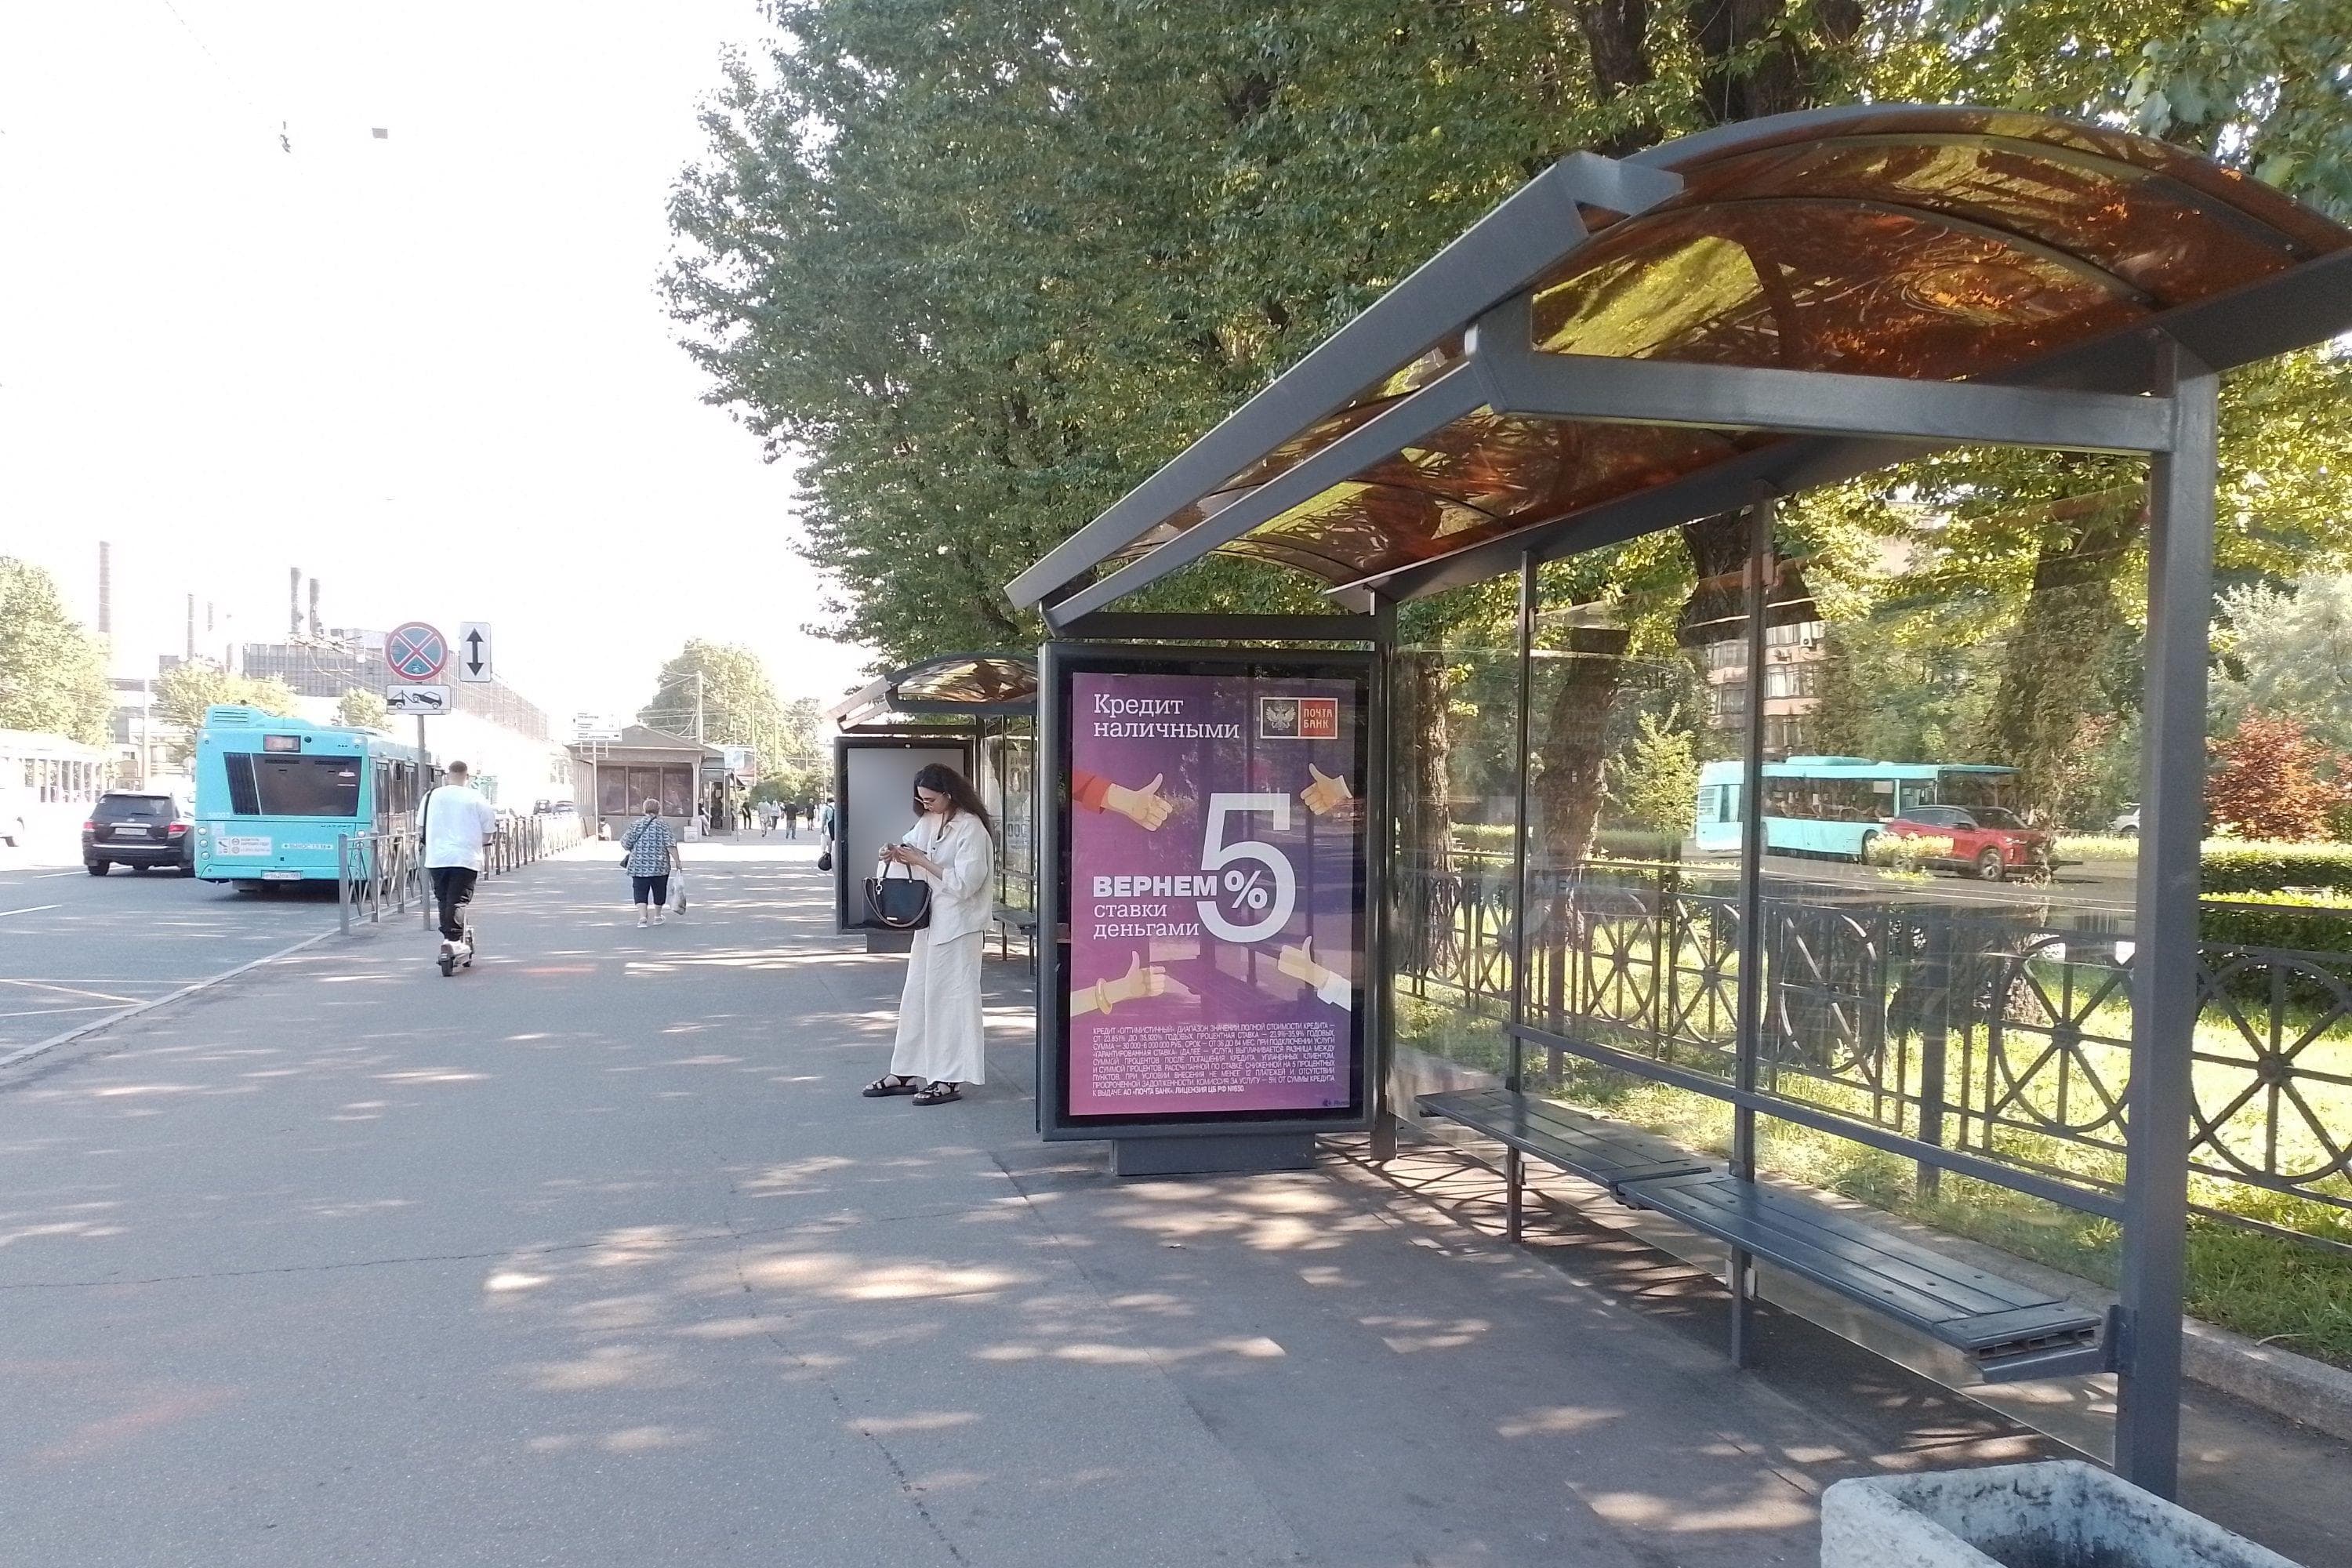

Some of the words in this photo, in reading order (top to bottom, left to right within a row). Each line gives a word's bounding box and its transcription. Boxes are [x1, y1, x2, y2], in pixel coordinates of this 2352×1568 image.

[1094, 693, 1184, 718] Кредит
[1304, 708, 1333, 718] ПОЧТА
[1093, 722, 1240, 739] наличными
[1303, 719, 1329, 729] БАНК
[1093, 875, 1218, 898] ВЕРНЕМ
[1094, 904, 1167, 918] ставки
[1093, 923, 1200, 940] деньгами
[1093, 1026, 1116, 1035] КРЕДИТ
[1240, 1023, 1265, 1032] ПОЛНОЙ
[1266, 1022, 1301, 1031] СТОИМОСТИ
[1303, 1022, 1328, 1030] КРЕДИТА
[1196, 1032, 1235, 1040] ПРОЦЕНТНАЯ
[1237, 1031, 1259, 1040] СТАВКА
[1269, 1037, 1312, 1046] ПОДКЛЮЧЕНИИ
[1313, 1036, 1334, 1045] УСЛУГИ
[1235, 1046, 1283, 1054] ВЫПЛАЧИВАЕТСЯ
[1286, 1045, 1312, 1054] РАЗНИЦА
[1314, 1044, 1334, 1053] МЕЖДУ
[1092, 1058, 1119, 1066] СУММОЙ
[1189, 1055, 1225, 1064] ПОГАШЕНИЯ
[1261, 1053, 1298, 1062] УПЛАЧЕННЫХ
[1098, 1065, 1125, 1074] СУММОЙ
[1164, 1062, 1209, 1072] РАССЧИТАННОЙ
[1210, 1062, 1220, 1071] ПО
[1245, 1061, 1281, 1069] СНИЖЕННОЙ
[1297, 1059, 1334, 1069] ПРОЦЕНТНЫХ
[1142, 1072, 1169, 1080] УСЛОВИИ
[1174, 1071, 1204, 1080] ВНЕСЕНИЯ
[1221, 1069, 1240, 1078] МЕНЕЕ
[1255, 1069, 1285, 1077] ПЛАТЕЖЕЙ
[1298, 1067, 1334, 1076] ОТСУТСТВИИ
[1092, 1080, 1140, 1089] ПРОСРОЧЕННОЙ
[1196, 1077, 1229, 1086] КОМИССИЯ
[1239, 1076, 1260, 1085] УСЛУГУ
[1174, 1086, 1207, 1094] ЛИЦЕНЗИЯ
